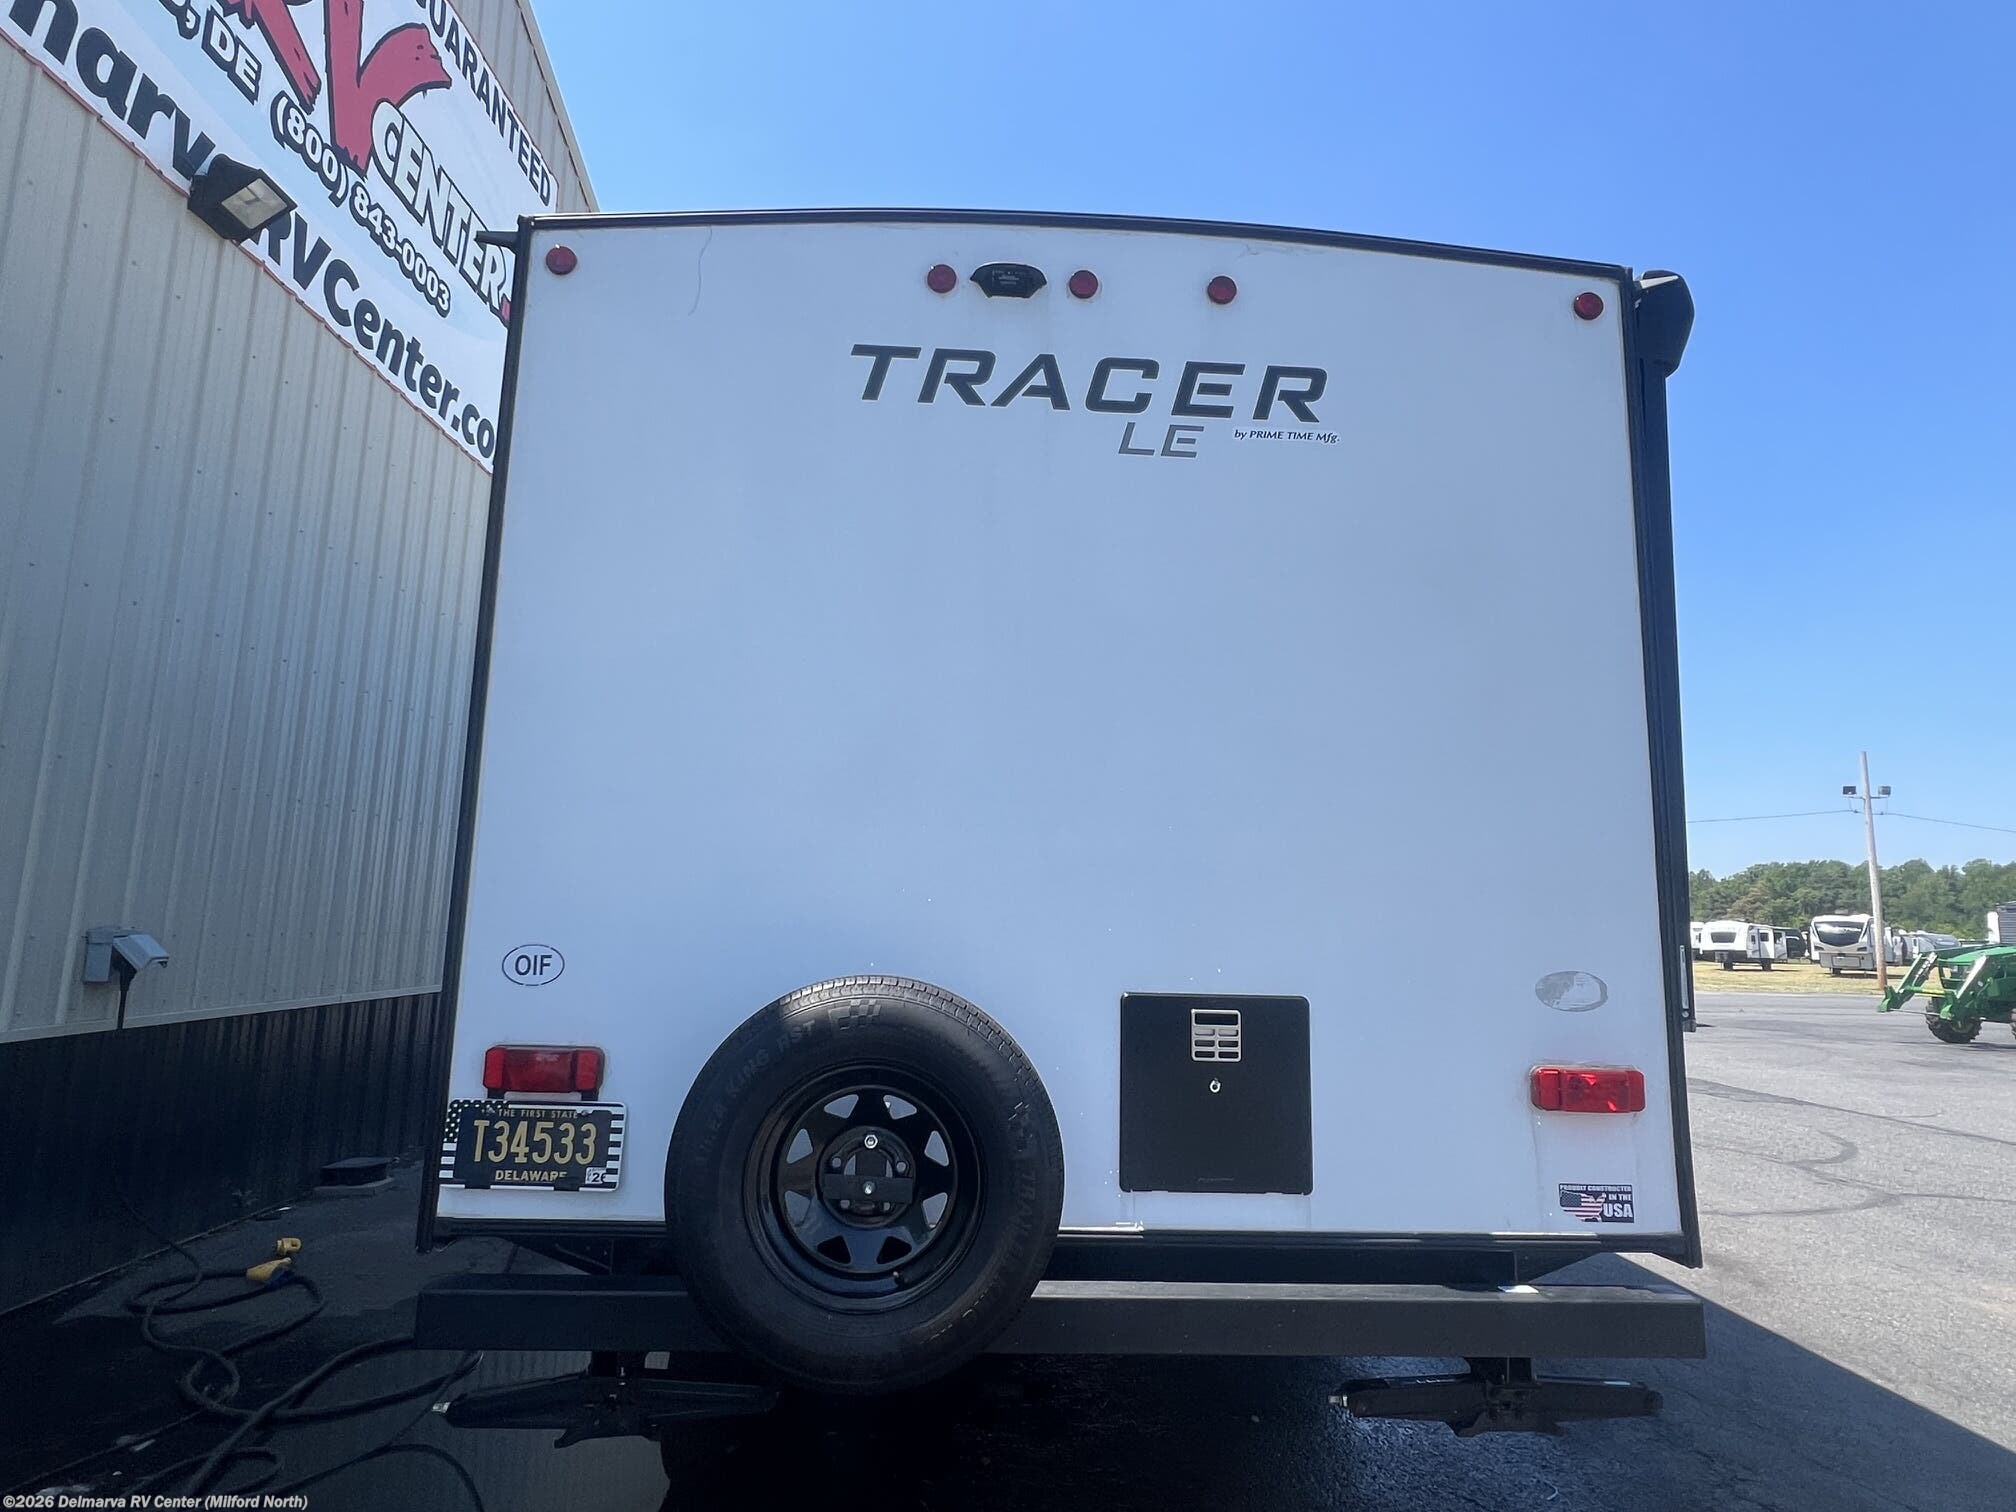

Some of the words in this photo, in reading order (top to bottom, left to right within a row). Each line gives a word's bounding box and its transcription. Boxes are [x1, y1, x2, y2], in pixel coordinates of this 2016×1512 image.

[415, 0, 551, 206] UARANTEED
[203, 10, 261, 104] DE
[271, 91, 348, 206] (800)
[350, 180, 450, 318] 843-0003
[850, 344, 1328, 423] TRACER
[1118, 422, 1205, 458] LE
[1234, 429, 1247, 440] by
[1249, 430, 1284, 440] PRIME
[1287, 431, 1314, 441] TIME
[514, 954, 553, 976] OIF
[498, 1109, 515, 1118] THE
[521, 1110, 546, 1119] FIRST
[551, 1110, 578, 1119] STATE
[473, 1119, 597, 1165] T34533
[1603, 1203, 1634, 1218] USA
[1608, 1193, 1617, 1201] IN
[1618, 1193, 1632, 1201] THE
